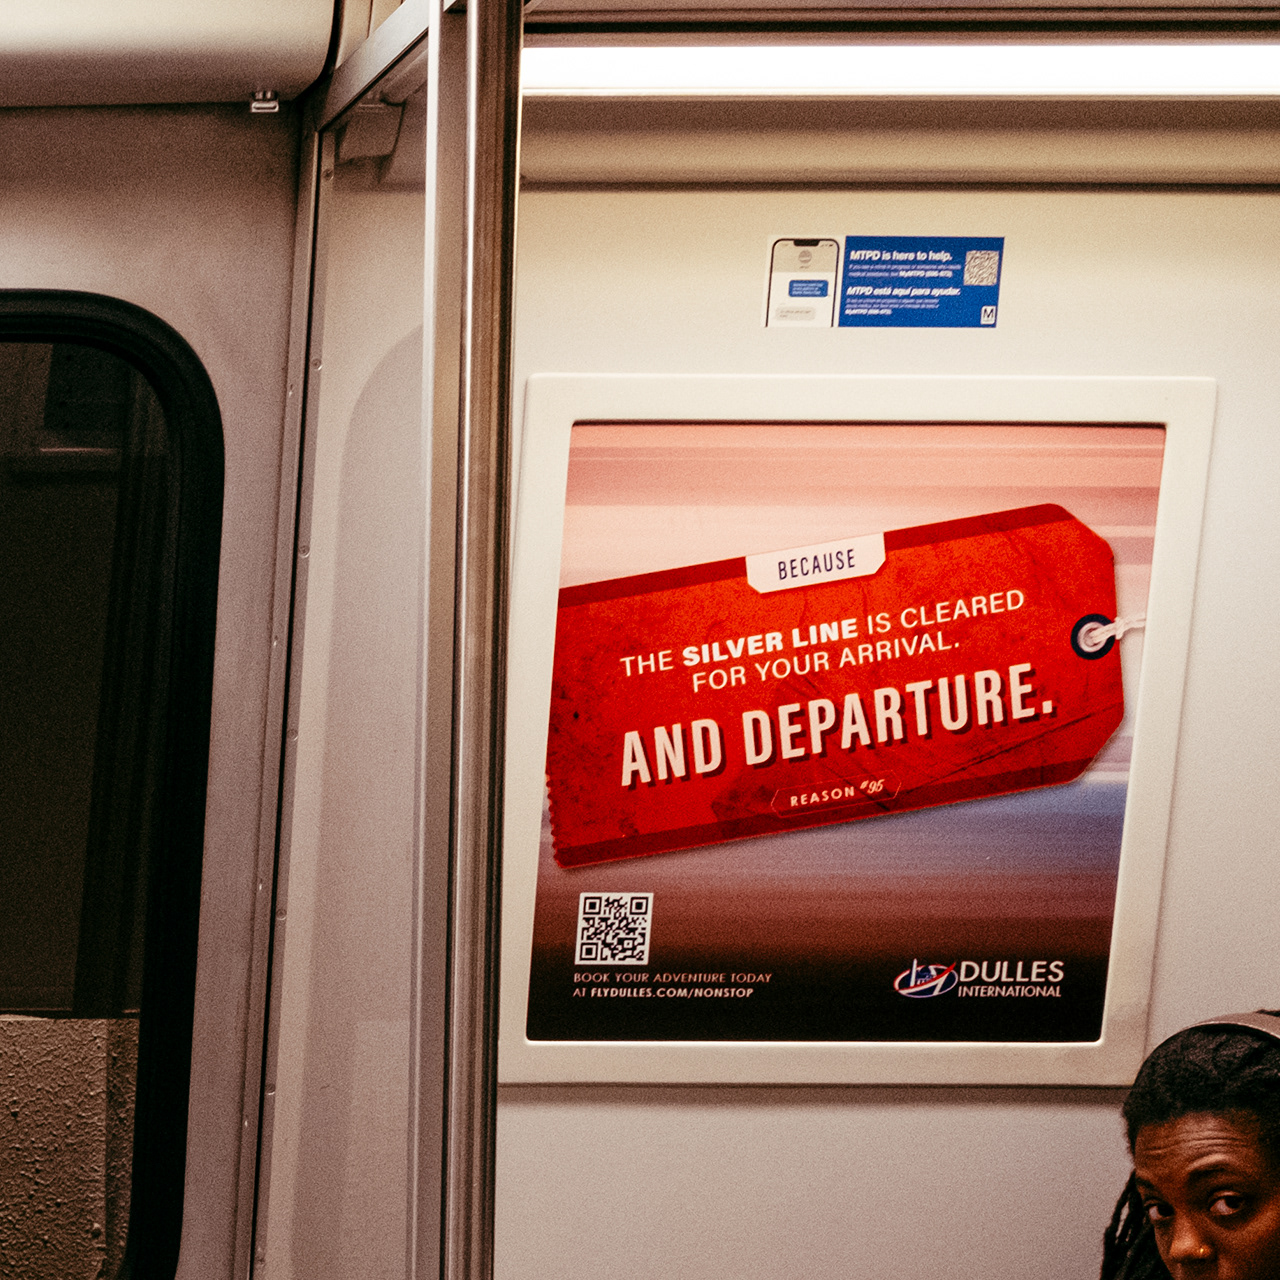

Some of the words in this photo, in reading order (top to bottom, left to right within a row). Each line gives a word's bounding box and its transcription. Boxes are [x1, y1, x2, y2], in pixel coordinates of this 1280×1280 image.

[850, 250, 880, 260] MTPD
[882, 251, 891, 260] is
[892, 251, 915, 260] here
[916, 251, 927, 260] to
[928, 251, 953, 262] help.
[846, 286, 873, 295] MTPD
[910, 287, 931, 297] para
[930, 286, 961, 297] ayudar.
[983, 308, 994, 319] M
[777, 549, 856, 581] BECAUSE
[619, 650, 674, 677] THE
[682, 632, 783, 667] SILVER
[792, 618, 858, 648] LINE
[867, 612, 892, 635] IS
[900, 589, 1024, 628] CLEARED
[692, 666, 747, 693] FOR
[755, 651, 830, 681] YOUR
[839, 631, 960, 668] ARRIVAL.
[621, 717, 724, 787] AND
[743, 662, 1054, 768] DEPARTURE.
[790, 786, 855, 807] REASON
[860, 779, 885, 794] #95
[573, 972, 610, 983] BOOK
[615, 972, 649, 983] YOUR
[653, 972, 726, 983] ADVENTURE
[730, 973, 773, 983] TODAY
[959, 960, 1065, 983] DULLES
[573, 987, 587, 998] AT
[590, 987, 754, 998] FLYDULLES.COM/NONSTOP
[958, 985, 1062, 998] INTERNATIONAL
